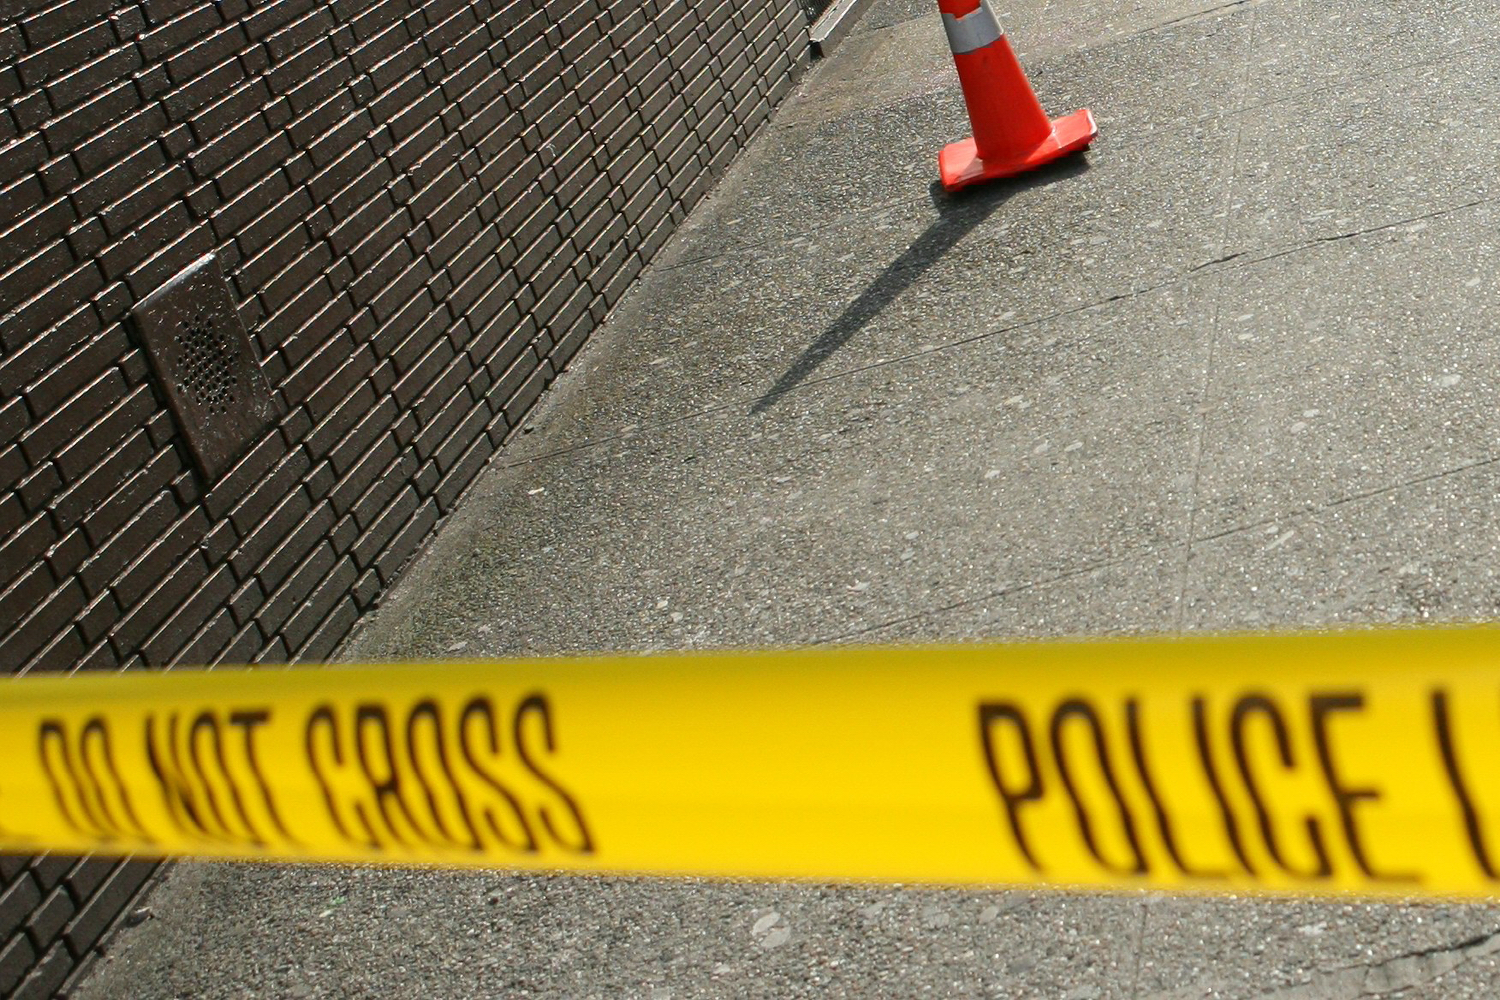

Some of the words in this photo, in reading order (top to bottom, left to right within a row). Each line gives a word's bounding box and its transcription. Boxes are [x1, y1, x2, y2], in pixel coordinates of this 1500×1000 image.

[34, 713, 156, 846] DO
[142, 708, 306, 849] NOT
[304, 687, 598, 857] CROSS
[974, 686, 1427, 890] POLICE
